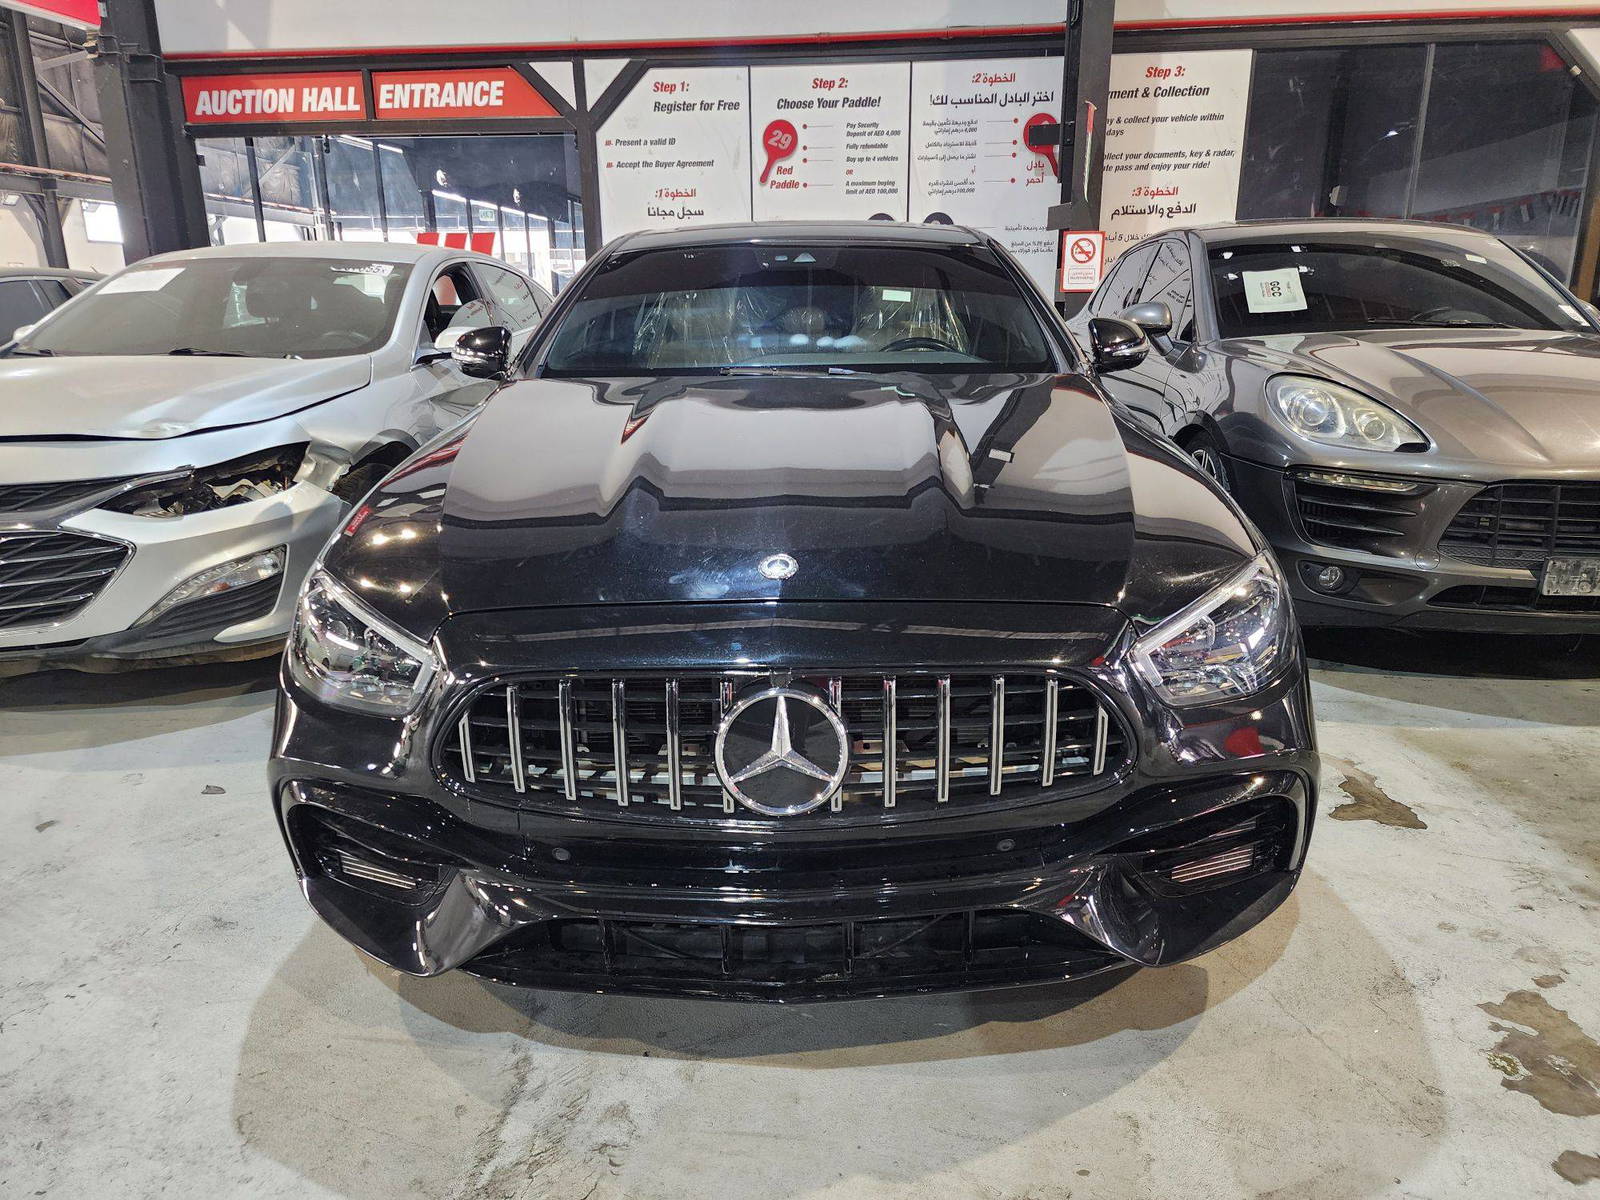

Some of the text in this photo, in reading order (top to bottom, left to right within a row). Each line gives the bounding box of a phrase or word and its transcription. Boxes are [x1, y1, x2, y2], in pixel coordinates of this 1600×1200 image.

[1145, 66, 1186, 80] Step 3:
[653, 81, 690, 94] Step 1:
[812, 77, 848, 91] Step 2:
[195, 81, 504, 116] AUCTION HALL ENTRANCE
[1032, 91, 1054, 106] اختر
[1108, 85, 1210, 99] ment & Collection
[777, 96, 881, 110] Choose Your Paddle!
[951, 93, 997, 109] المناسب
[1000, 92, 1030, 107] البادل
[654, 100, 740, 114] Register for Free
[1116, 116, 1122, 124] &
[1124, 115, 1150, 124] collect
[1151, 117, 1169, 125] your
[1170, 114, 1198, 122] vehicle
[1200, 113, 1224, 121] within
[768, 130, 792, 150] 29
[1106, 129, 1124, 137] days
[650, 138, 667, 146] valid
[1125, 153, 1142, 161] your
[1144, 150, 1188, 159] documents,
[1189, 150, 1204, 158] key
[1205, 149, 1211, 157] &
[1212, 149, 1234, 157] radar,
[616, 161, 640, 169] Accept
[655, 160, 675, 169] Buyer
[676, 160, 714, 169] Agreement
[776, 166, 793, 175] Red
[1115, 164, 1133, 173] pass
[1134, 162, 1149, 170] and
[1151, 162, 1171, 171] enjoy
[1173, 162, 1190, 170] your
[1192, 161, 1210, 169] ride!
[770, 180, 800, 189] Paddle
[677, 206, 704, 220] سجل
[1111, 201, 1197, 220] الدفع والاستلام
[1270, 280, 1282, 297] GCC
